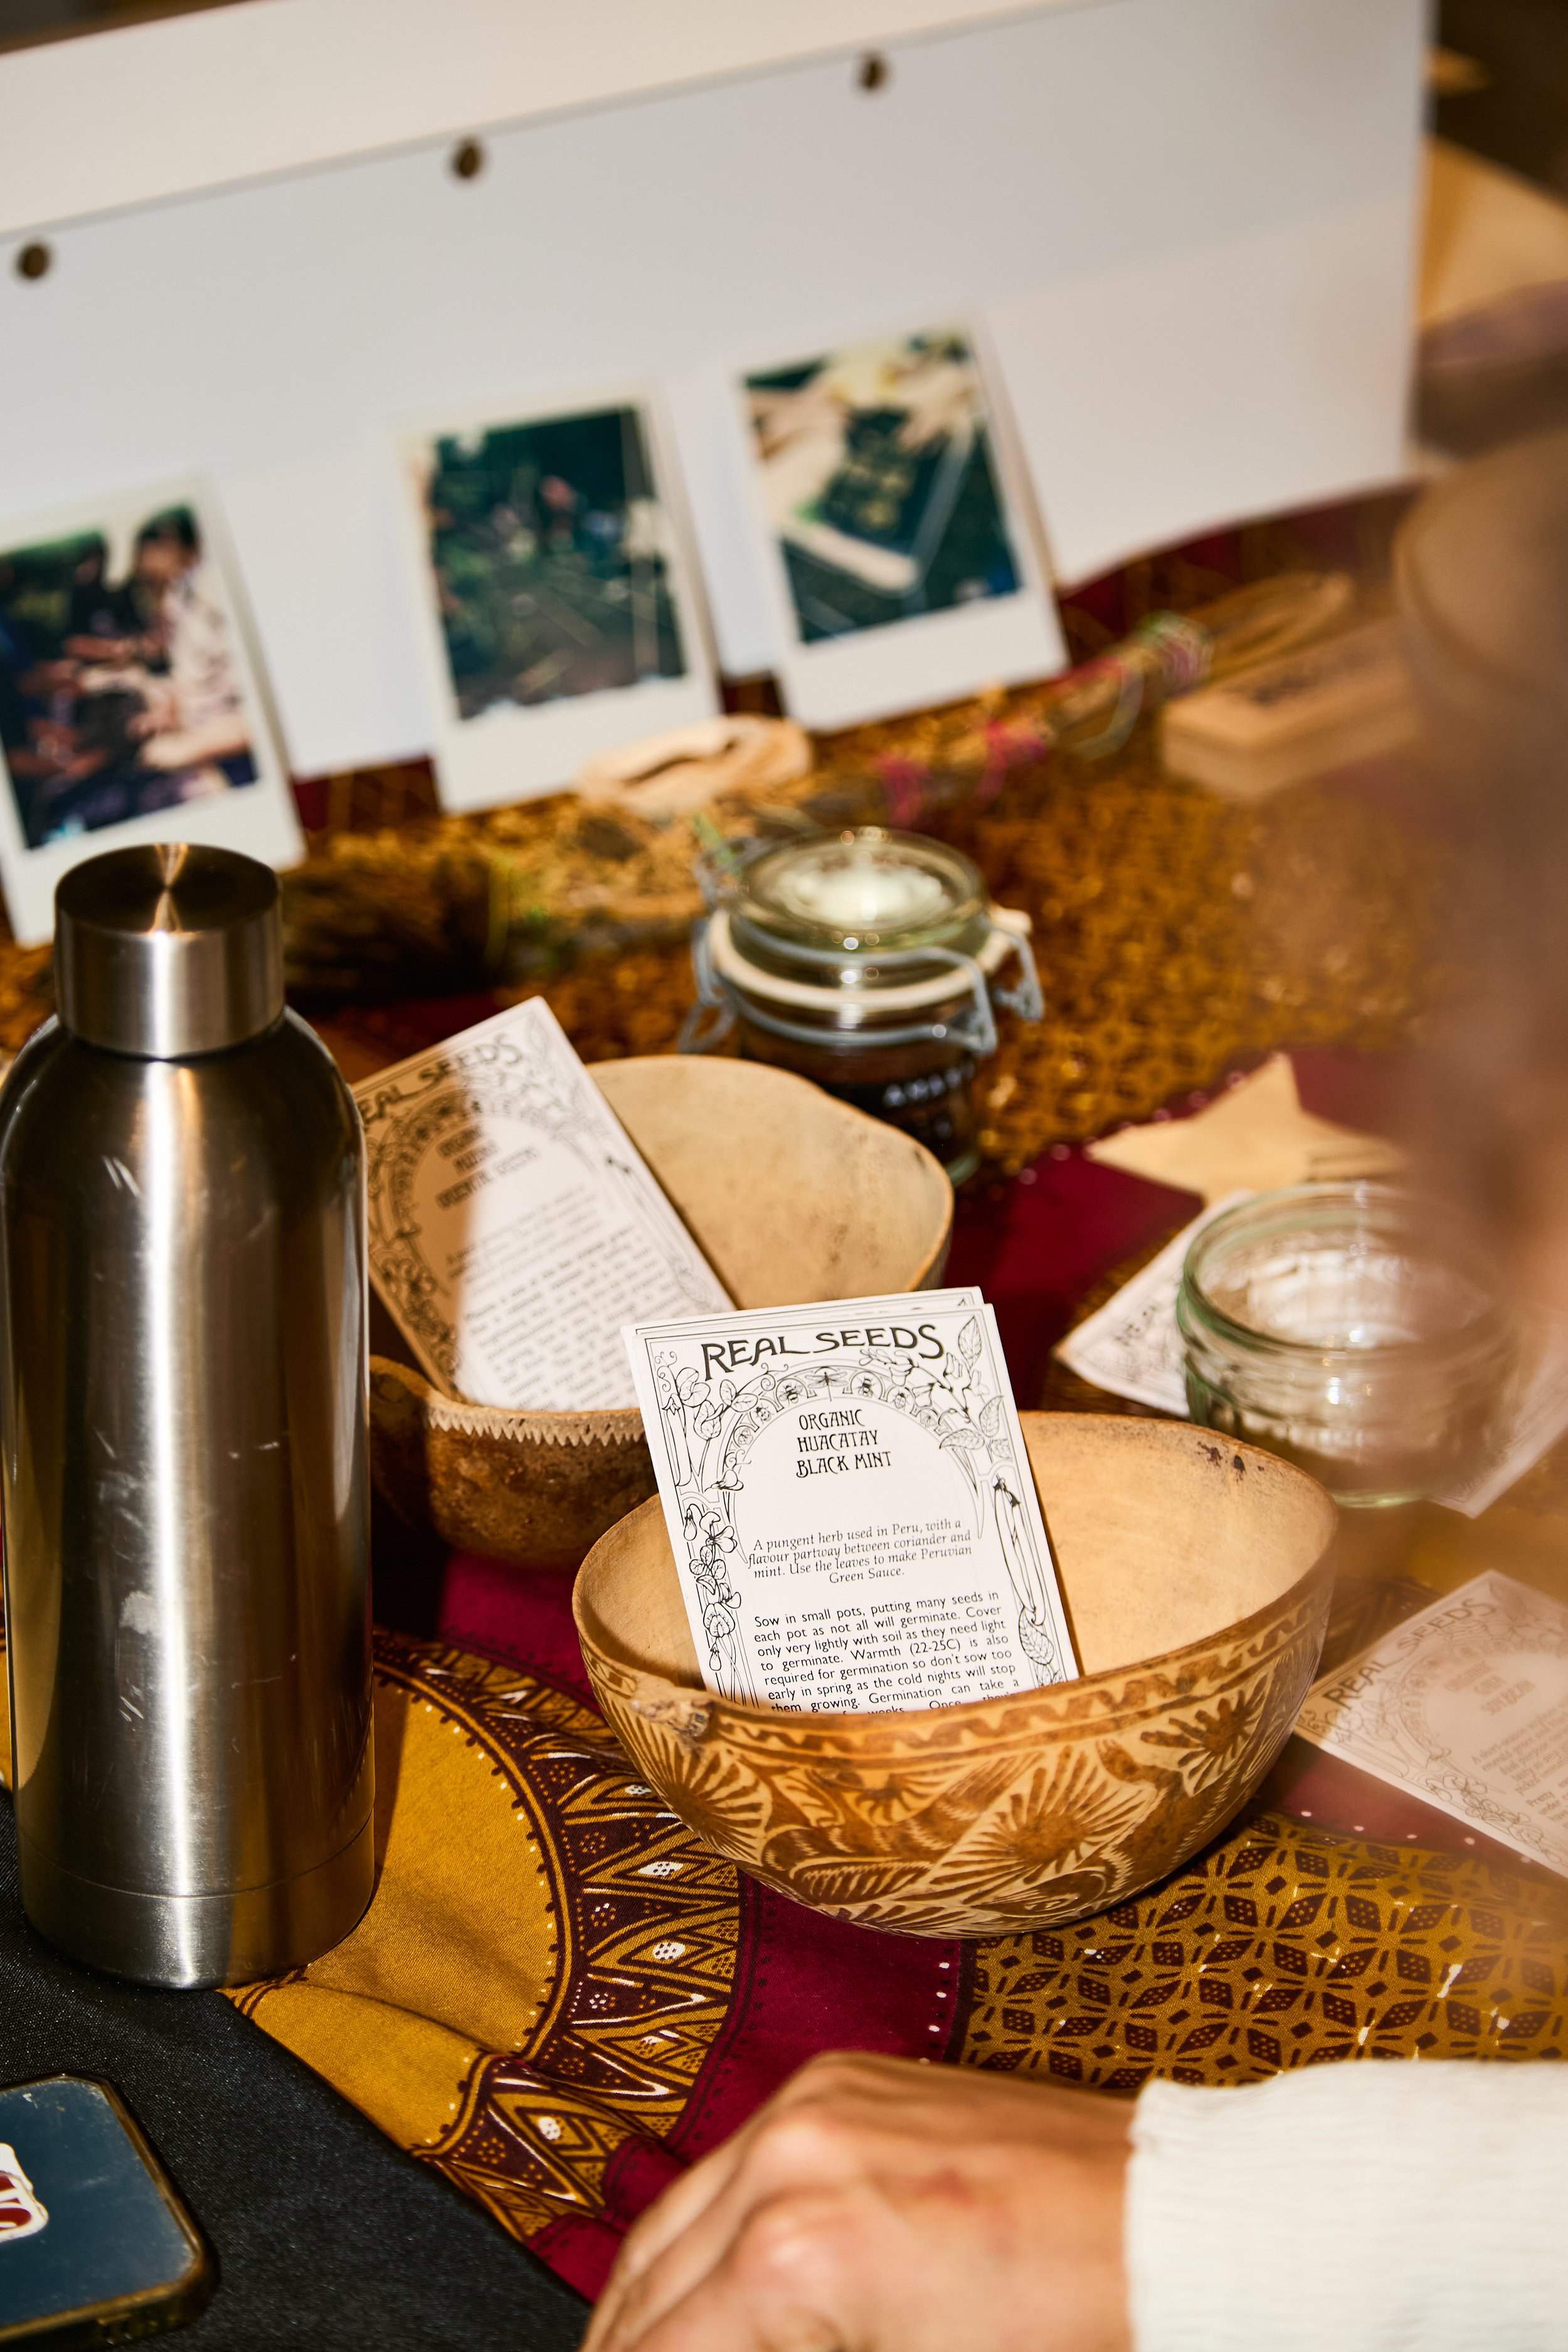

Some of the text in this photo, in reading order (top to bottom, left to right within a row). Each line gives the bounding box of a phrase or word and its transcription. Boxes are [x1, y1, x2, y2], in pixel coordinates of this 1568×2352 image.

[413, 1034, 522, 1094] SEEDS
[701, 1323, 945, 1381] REAL SEEDS
[798, 1409, 866, 1431] ORGANIC
[797, 1430, 878, 1453] HUACATAY
[796, 1451, 892, 1478] BLACK MINT
[748, 1529, 972, 1569] flavour partway between coriander and
[753, 1539, 763, 1550] A
[766, 1534, 815, 1553] pungent
[818, 1530, 844, 1544] herb
[847, 1526, 872, 1540] used
[876, 1525, 888, 1537] in
[892, 1523, 923, 1536] Peru,
[926, 1518, 951, 1532] with
[754, 1545, 972, 1579] mint. Use the leaves to make Peruvian
[829, 1567, 905, 1584] Green Sauce.
[754, 1590, 1000, 1628] Sow in small pots, putting many seeds in
[754, 1606, 1002, 1643] each pot as not all will germinate. Cover
[757, 1619, 1007, 1658] only very lightly with soil as they need light
[761, 1634, 1009, 1672] to germinate. Warmth (22-25C) is also
[1322, 1597, 1496, 1710] REAL SEEDS
[765, 1650, 1012, 1687] required for germination so don't sow too
[768, 1664, 1016, 1702] early in spring as the cold nights will stop
[771, 1703, 802, 1713] them
[810, 1697, 861, 1713] growing.
[868, 1687, 943, 1705] Germination
[951, 1684, 971, 1695] can
[979, 1679, 1005, 1692] take
[1013, 1678, 1020, 1687] a
